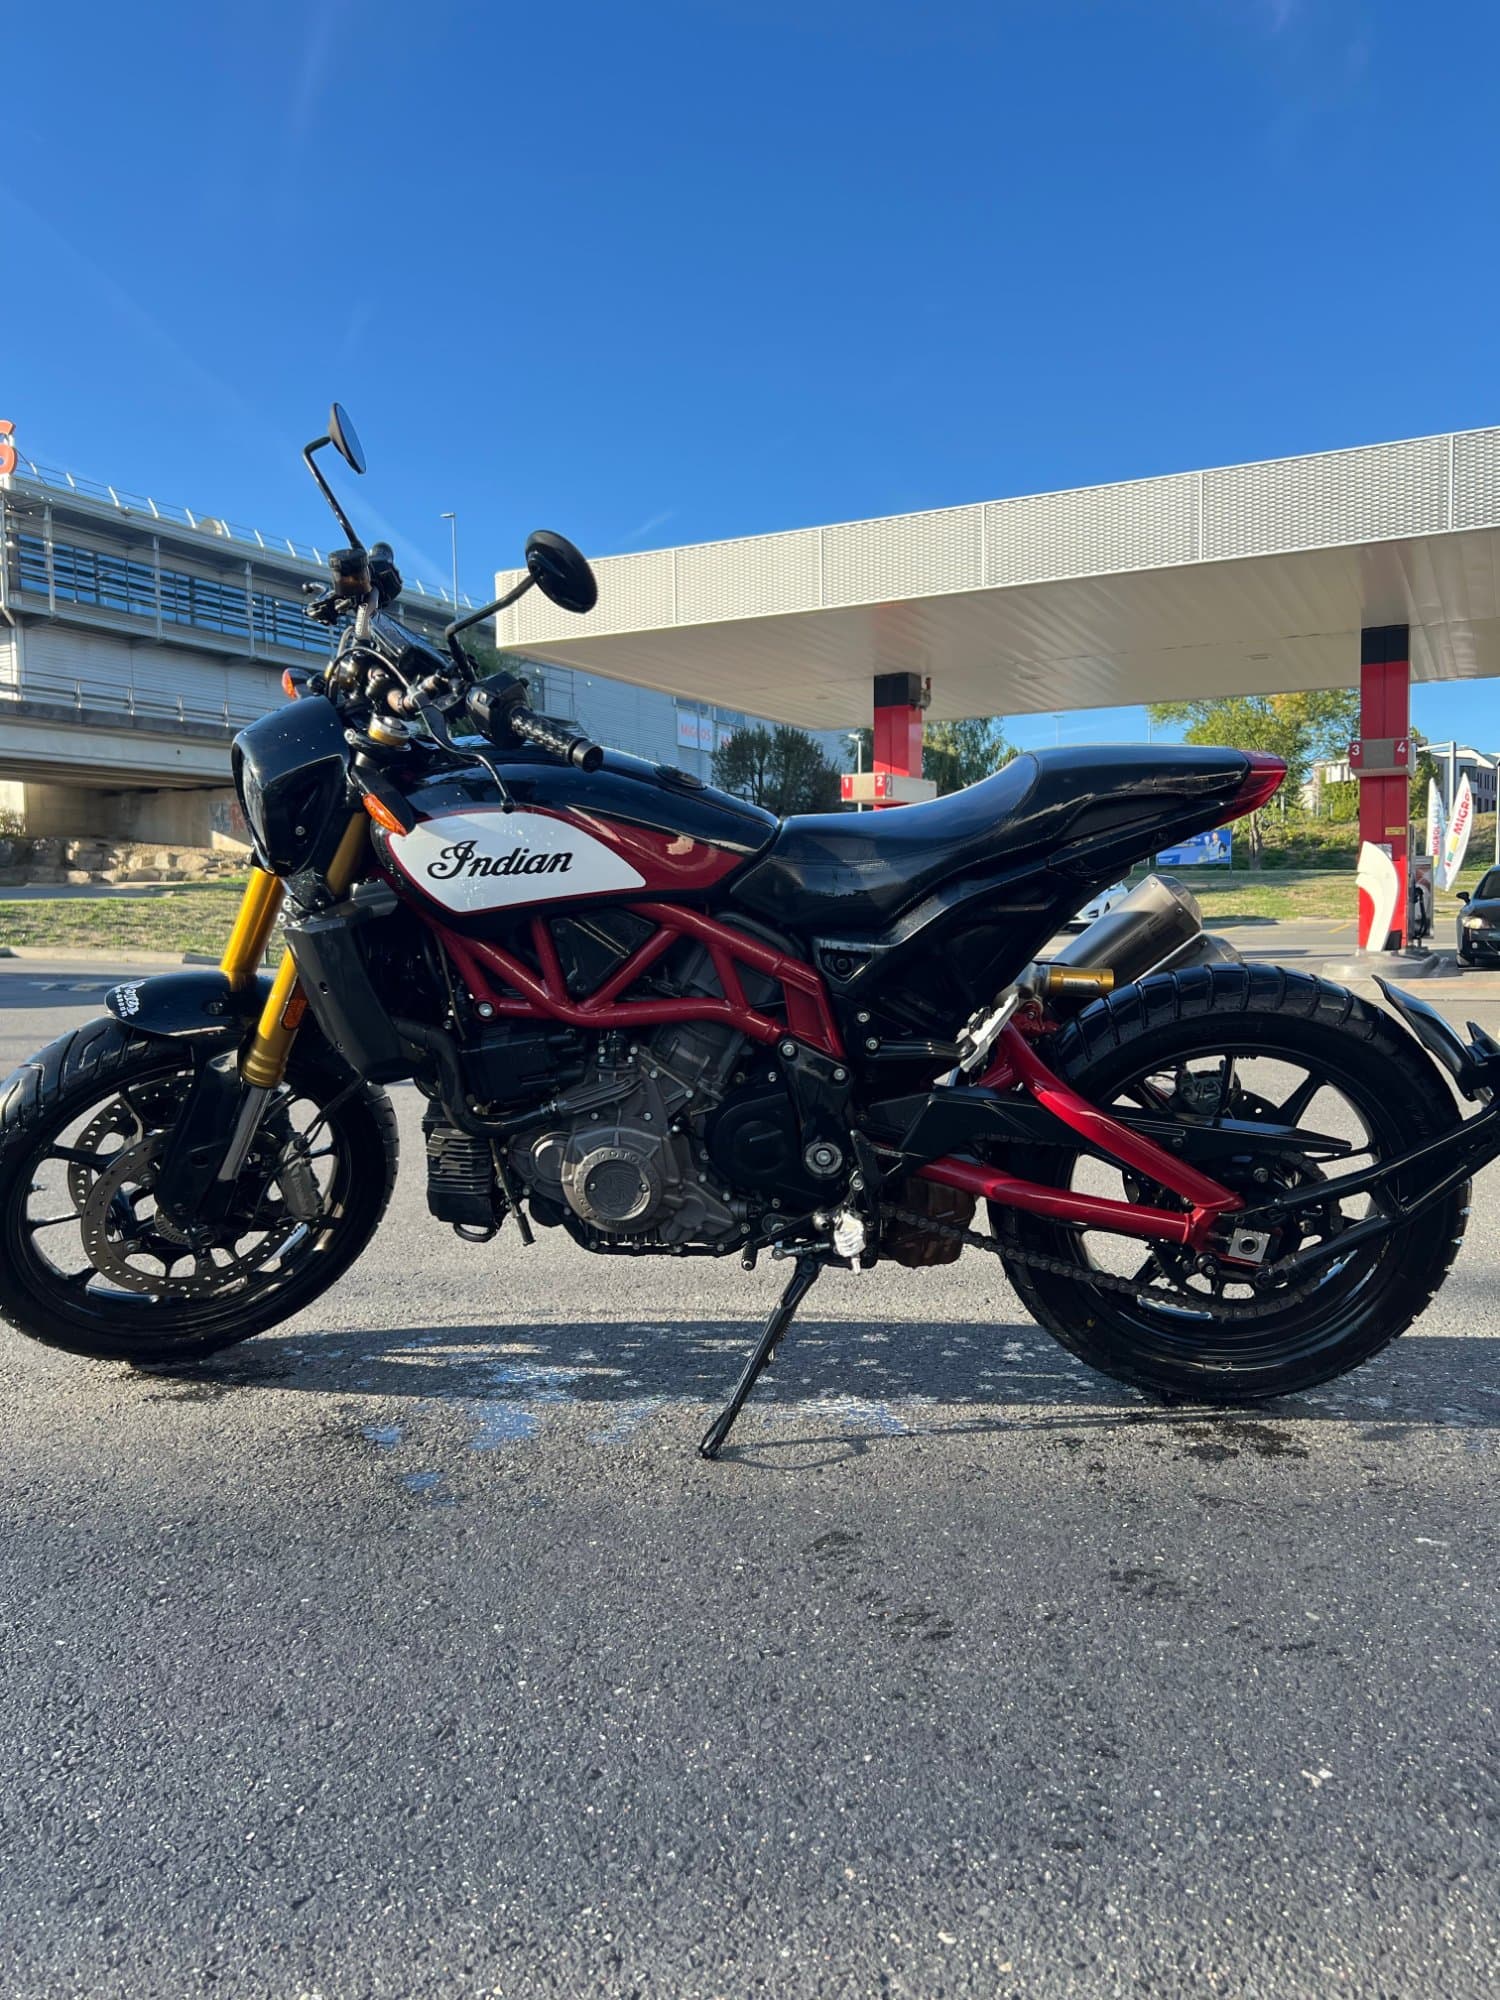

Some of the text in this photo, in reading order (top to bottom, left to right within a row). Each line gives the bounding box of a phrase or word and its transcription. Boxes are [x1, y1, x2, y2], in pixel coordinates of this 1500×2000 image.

[1351, 744, 1360, 756] 3
[1397, 741, 1406, 753] 4
[844, 778, 849, 788] 1
[877, 776, 883, 786] 2
[1453, 787, 1471, 836] MIGRO
[427, 839, 573, 880] Indian
